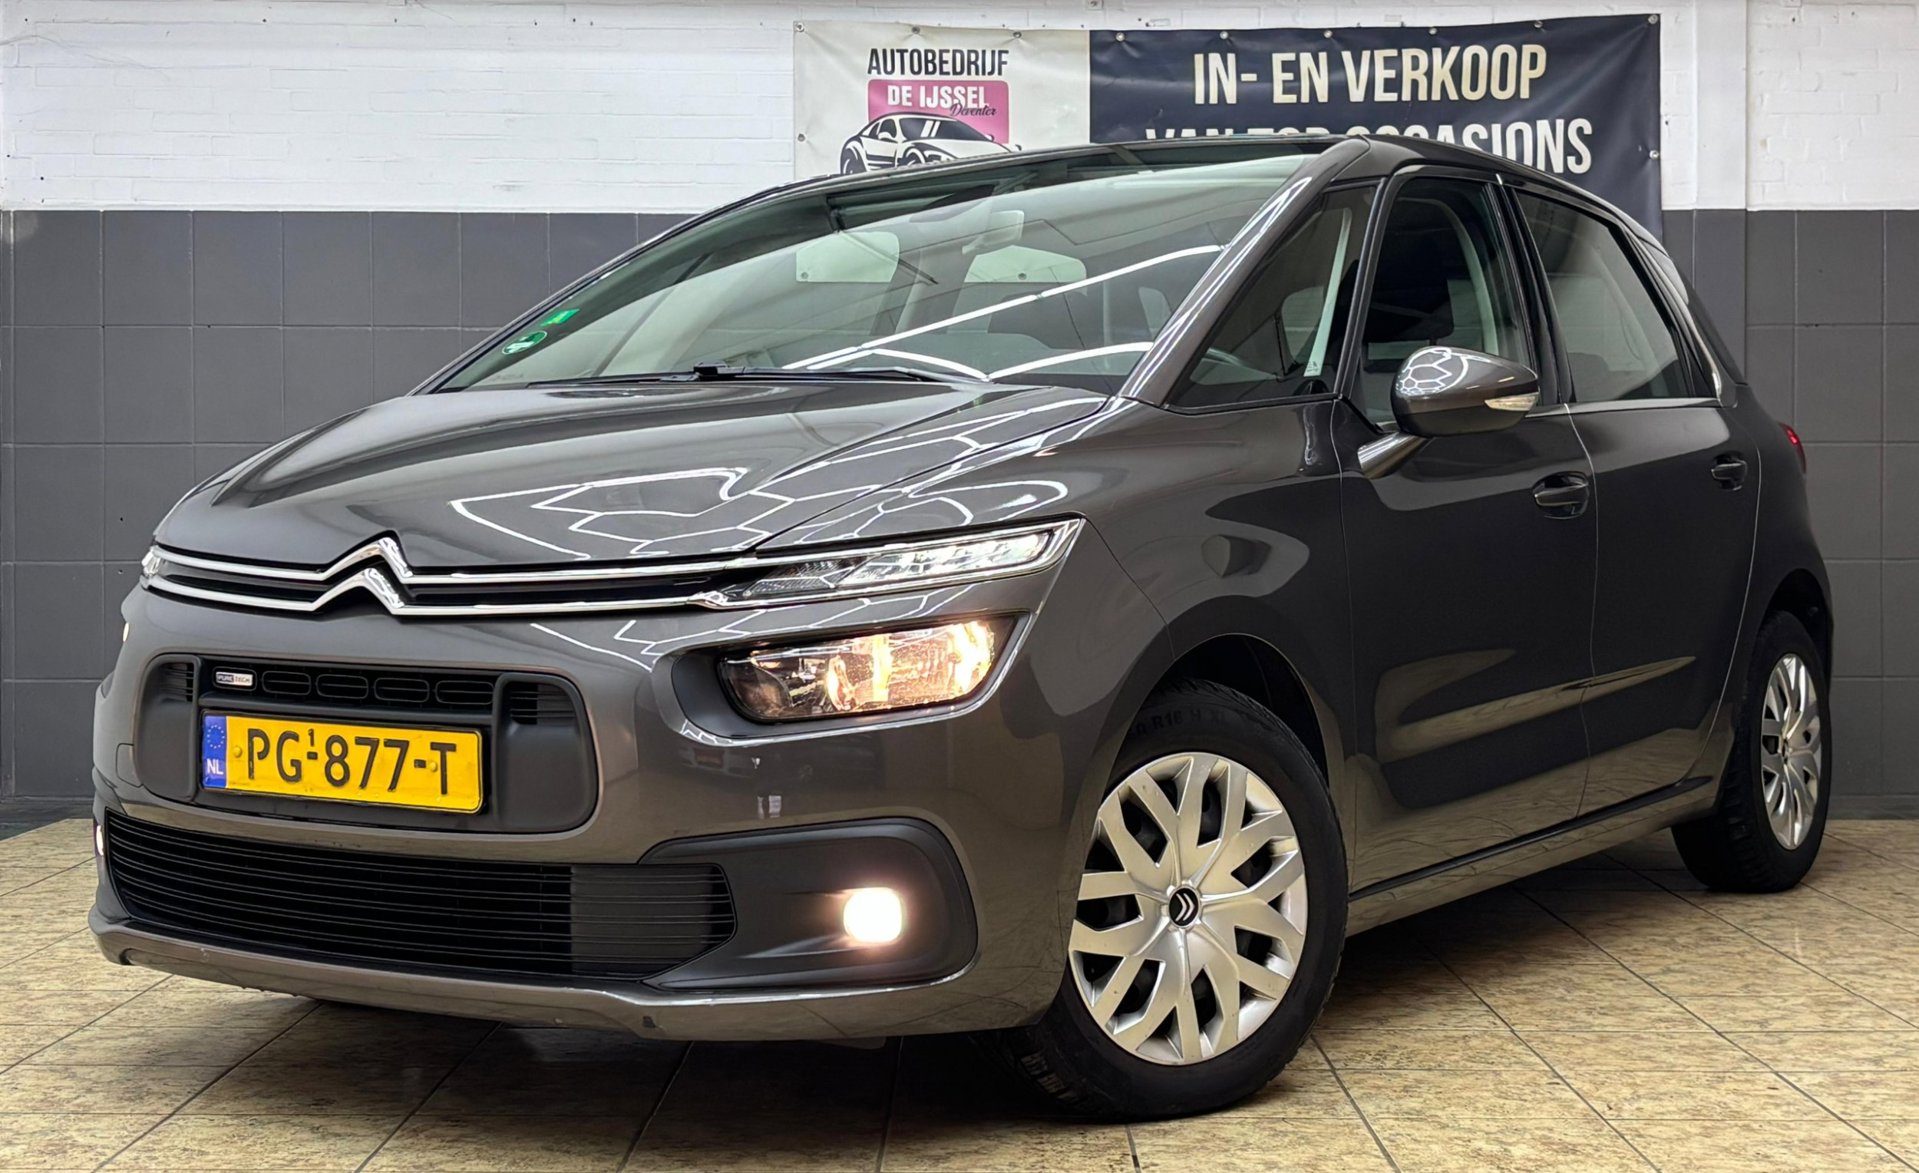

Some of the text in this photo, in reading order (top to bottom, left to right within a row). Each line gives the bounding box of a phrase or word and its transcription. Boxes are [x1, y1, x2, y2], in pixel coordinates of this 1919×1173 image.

[867, 48, 1009, 76] AUTOBEDRIJF
[1194, 44, 1546, 104] IN- EN VERKOOP
[887, 85, 989, 109] DE IJSSEL
[950, 102, 997, 117] Deventer
[206, 758, 224, 775] NL
